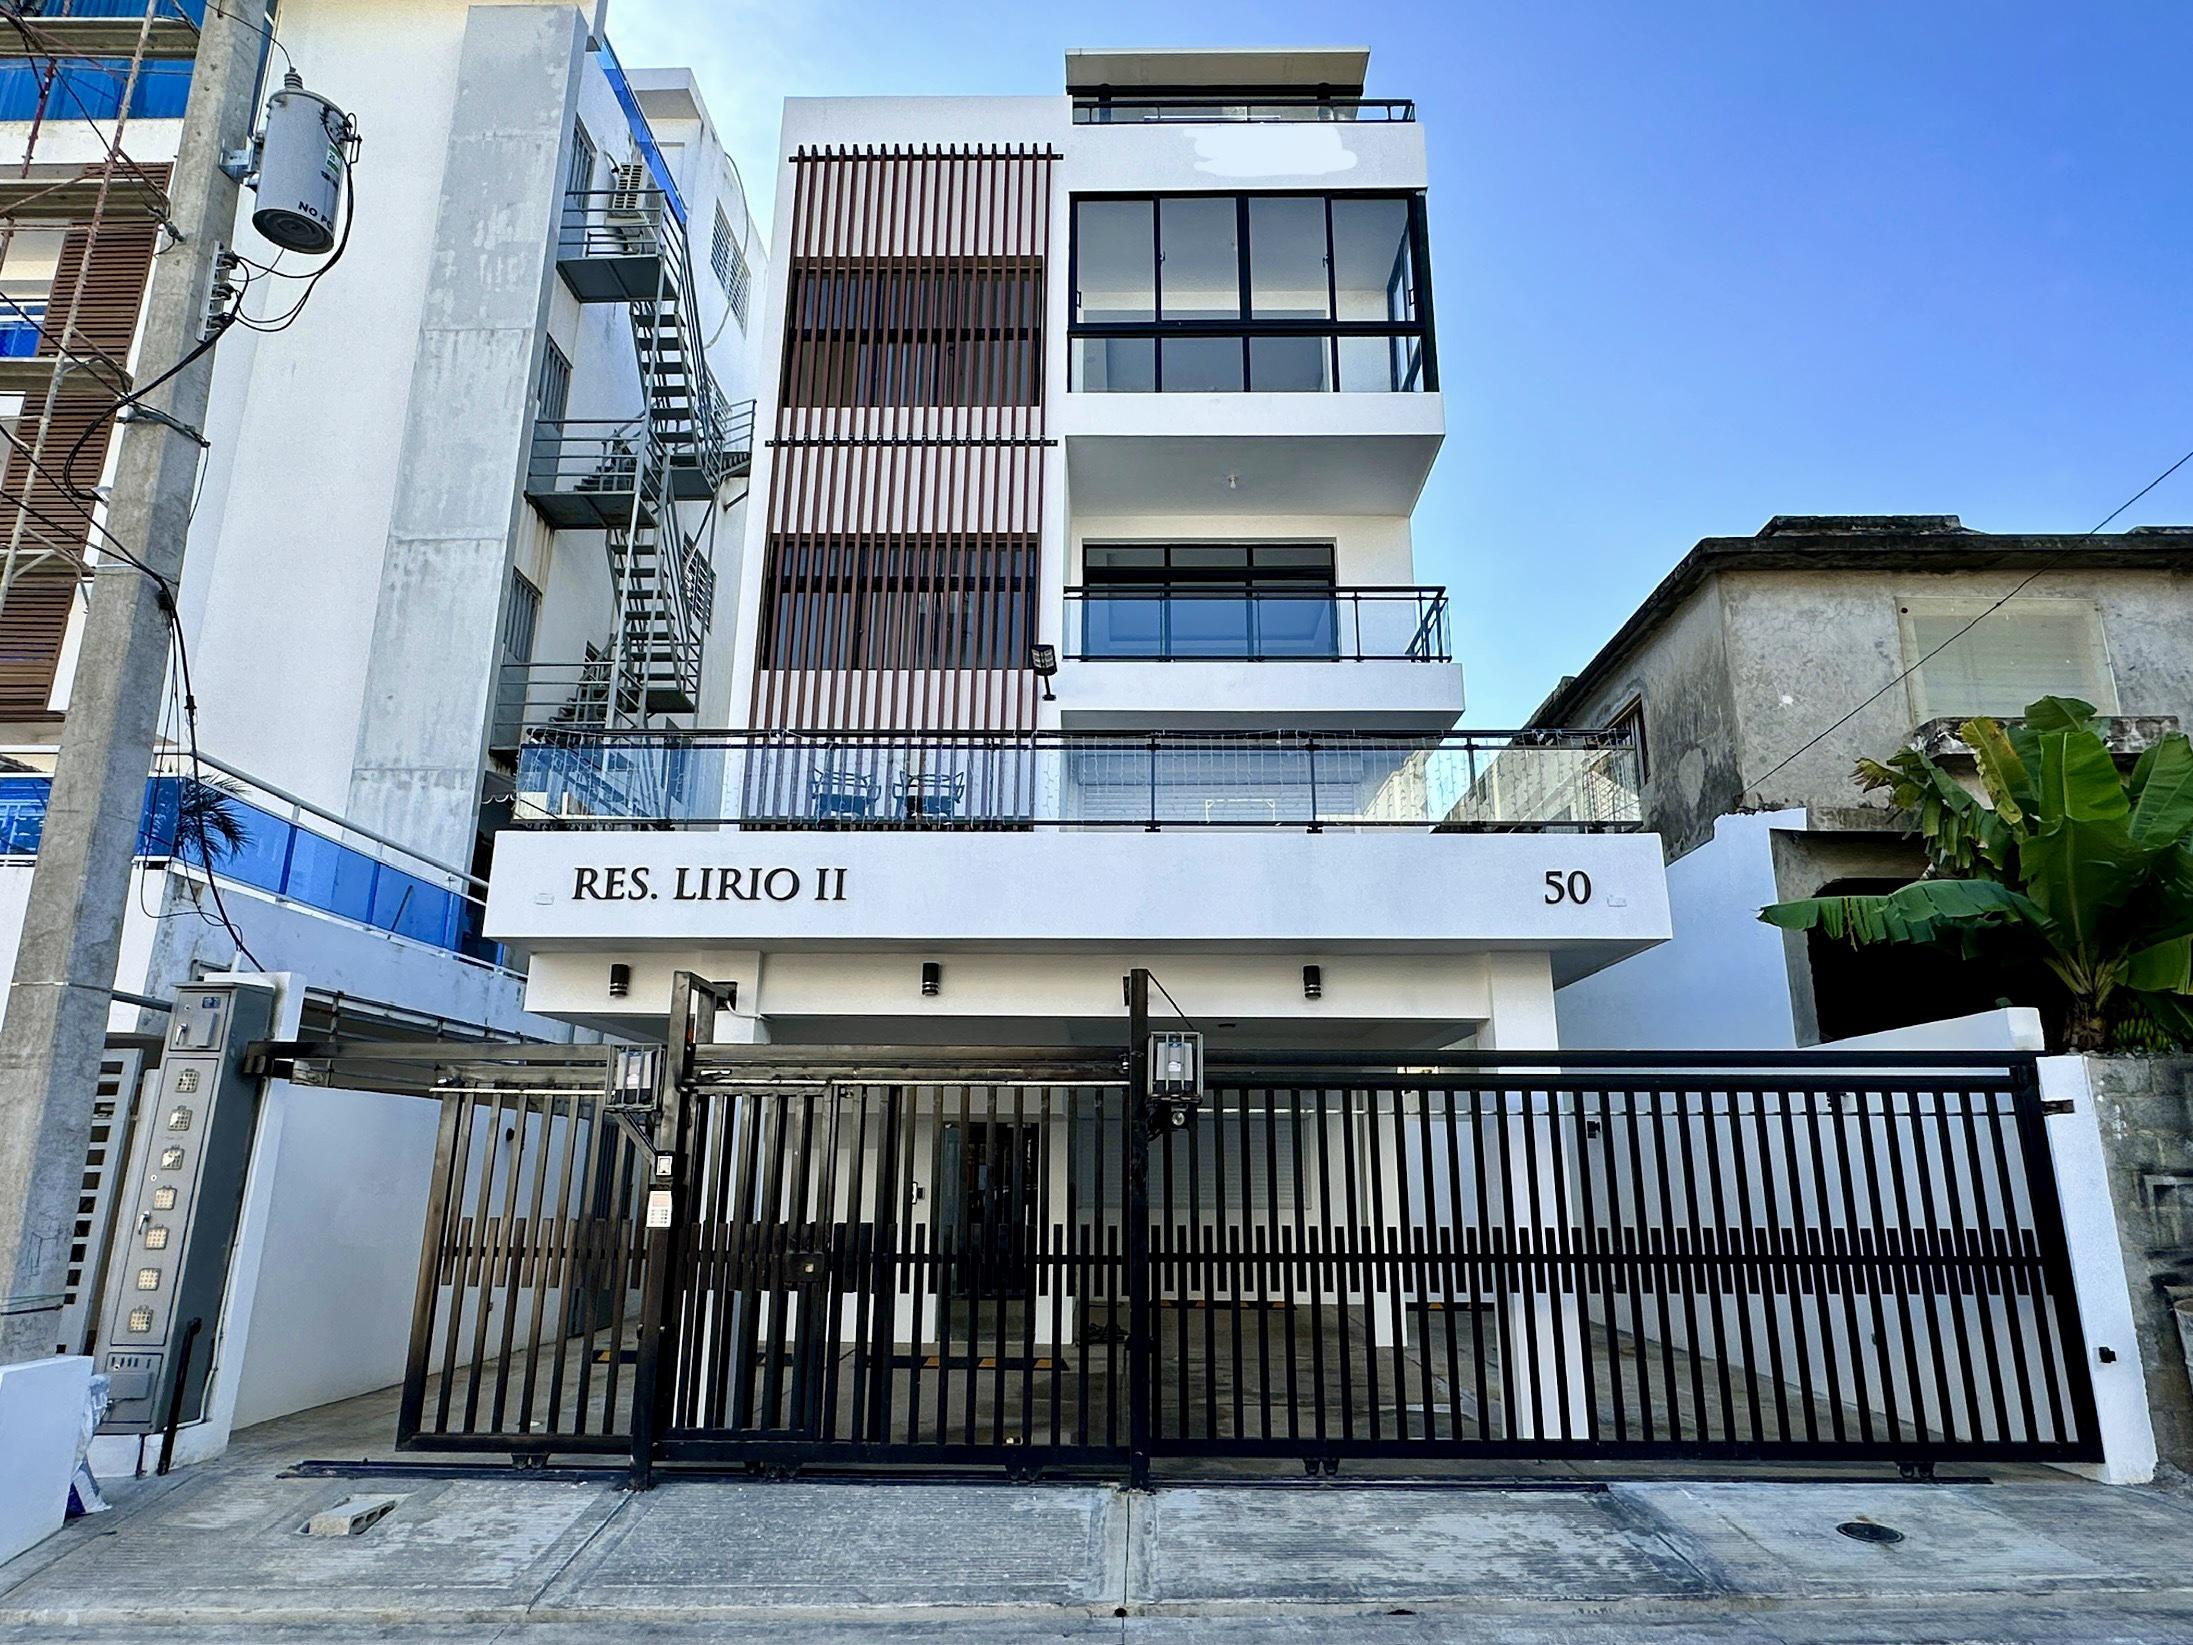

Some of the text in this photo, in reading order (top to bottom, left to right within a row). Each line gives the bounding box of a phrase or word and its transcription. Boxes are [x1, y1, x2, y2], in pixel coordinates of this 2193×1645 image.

[298, 201, 318, 217] NO
[572, 867, 848, 901] RES. LIRIO II
[1544, 870, 1592, 905] 50
